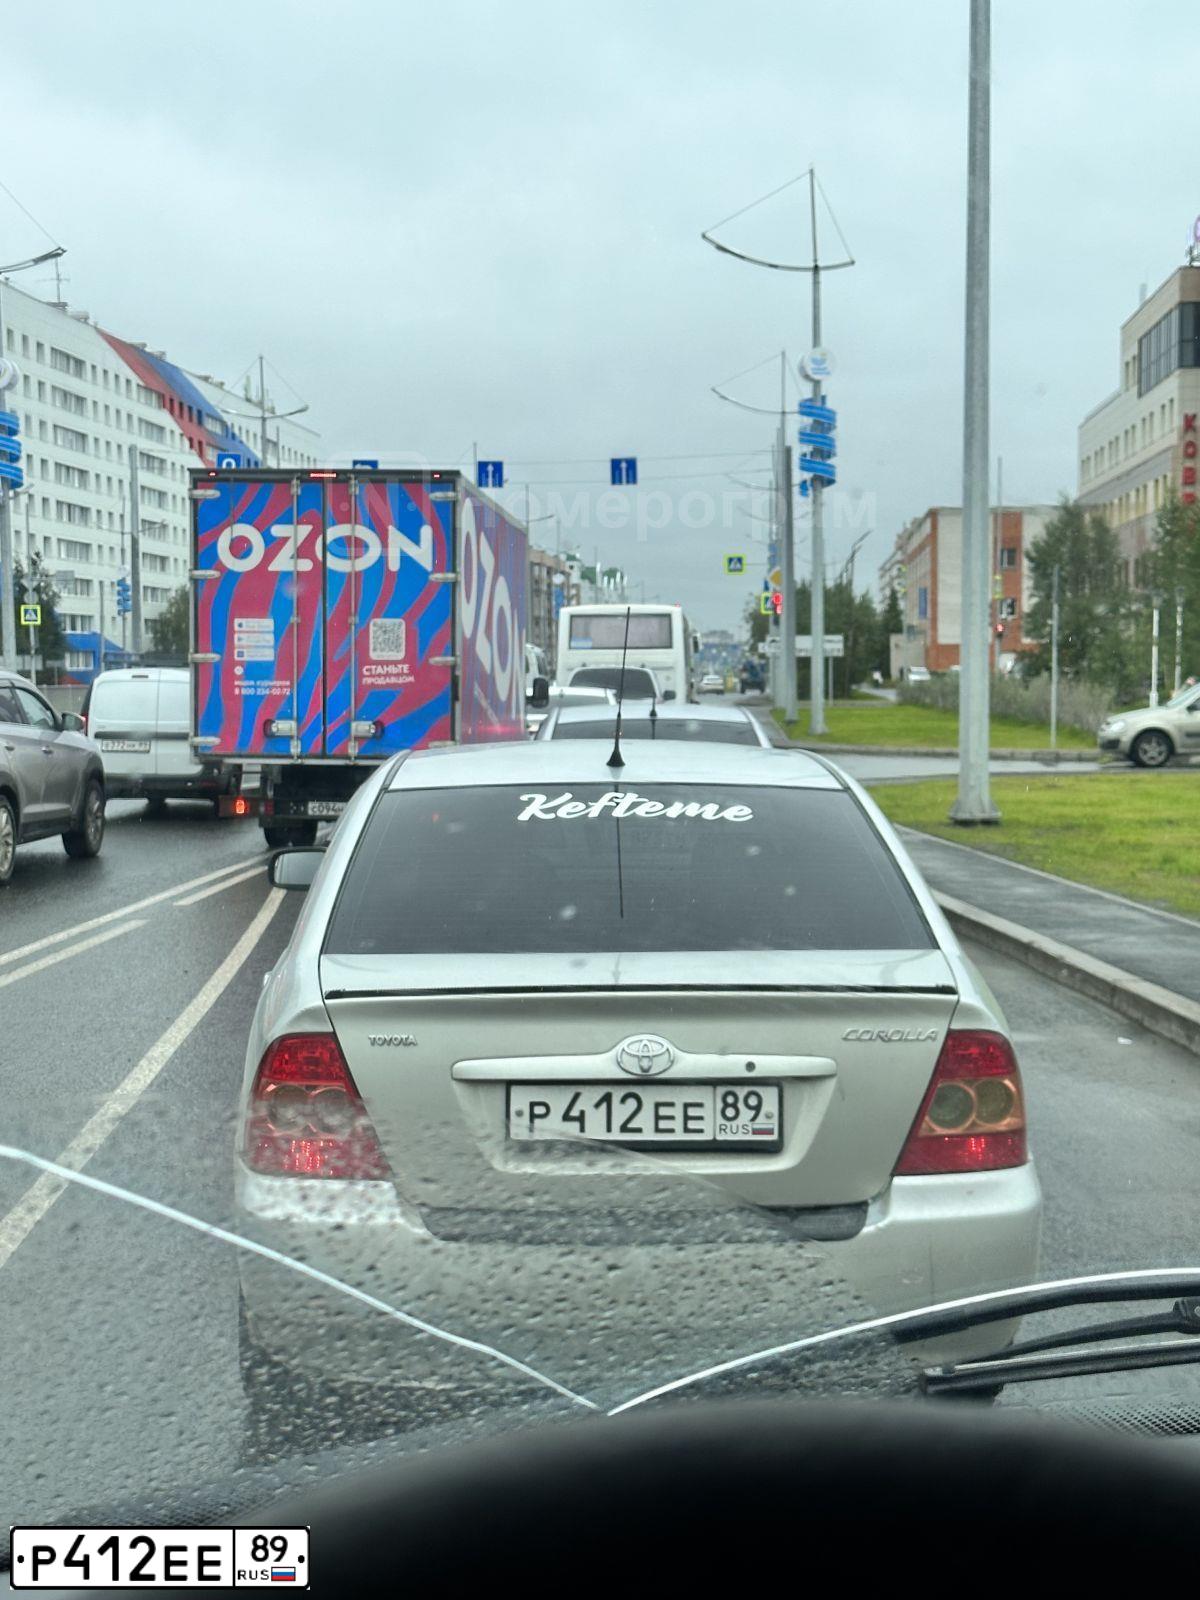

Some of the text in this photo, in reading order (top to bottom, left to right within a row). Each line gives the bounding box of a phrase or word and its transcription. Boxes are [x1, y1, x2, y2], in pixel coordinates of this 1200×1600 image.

[216, 522, 433, 573] OZON
[461, 497, 525, 735] OZON
[362, 664, 410, 676] СТАНЬТЕ
[517, 792, 754, 822] Kefteme
[368, 1034, 418, 1047] TOYOTA
[841, 1028, 939, 1043] COROLLA
[720, 1090, 763, 1122] 89
[718, 1123, 750, 1135] RUS
